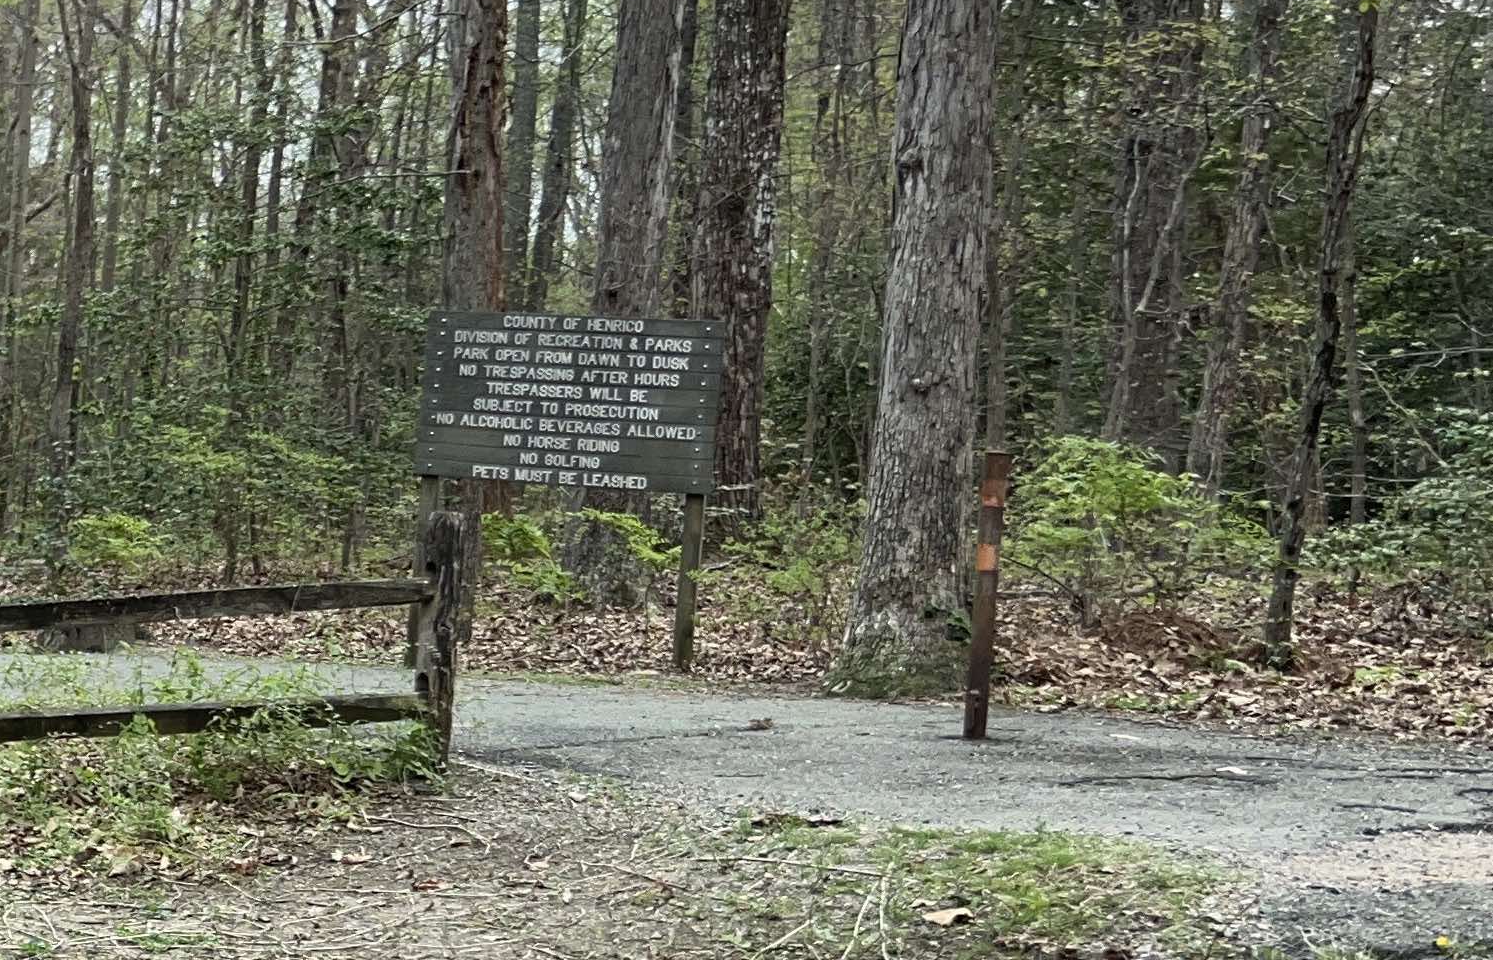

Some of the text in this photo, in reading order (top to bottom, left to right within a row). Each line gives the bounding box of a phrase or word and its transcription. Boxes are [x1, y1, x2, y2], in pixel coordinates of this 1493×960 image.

[503, 315, 644, 333] COUNTY OF HENRICO
[454, 330, 692, 352] DIVISION OF RECREATION & PARKS
[453, 346, 689, 370] PARK OPEN FROM DAWN TO DUSK
[459, 364, 680, 387] NO TRESPASSING AFTER HOURS
[486, 382, 648, 403] TRESPASSERS WILL BE
[473, 398, 658, 421] SUBJECT TO PROSECUTION
[436, 412, 696, 440] NO ALCOHOLIC BEVERAGES ALLOWED
[503, 434, 620, 453] NO HORSE RIDING
[519, 452, 600, 469] NO GOLFING
[472, 465, 647, 489] PETS MUST BE LEASHED
